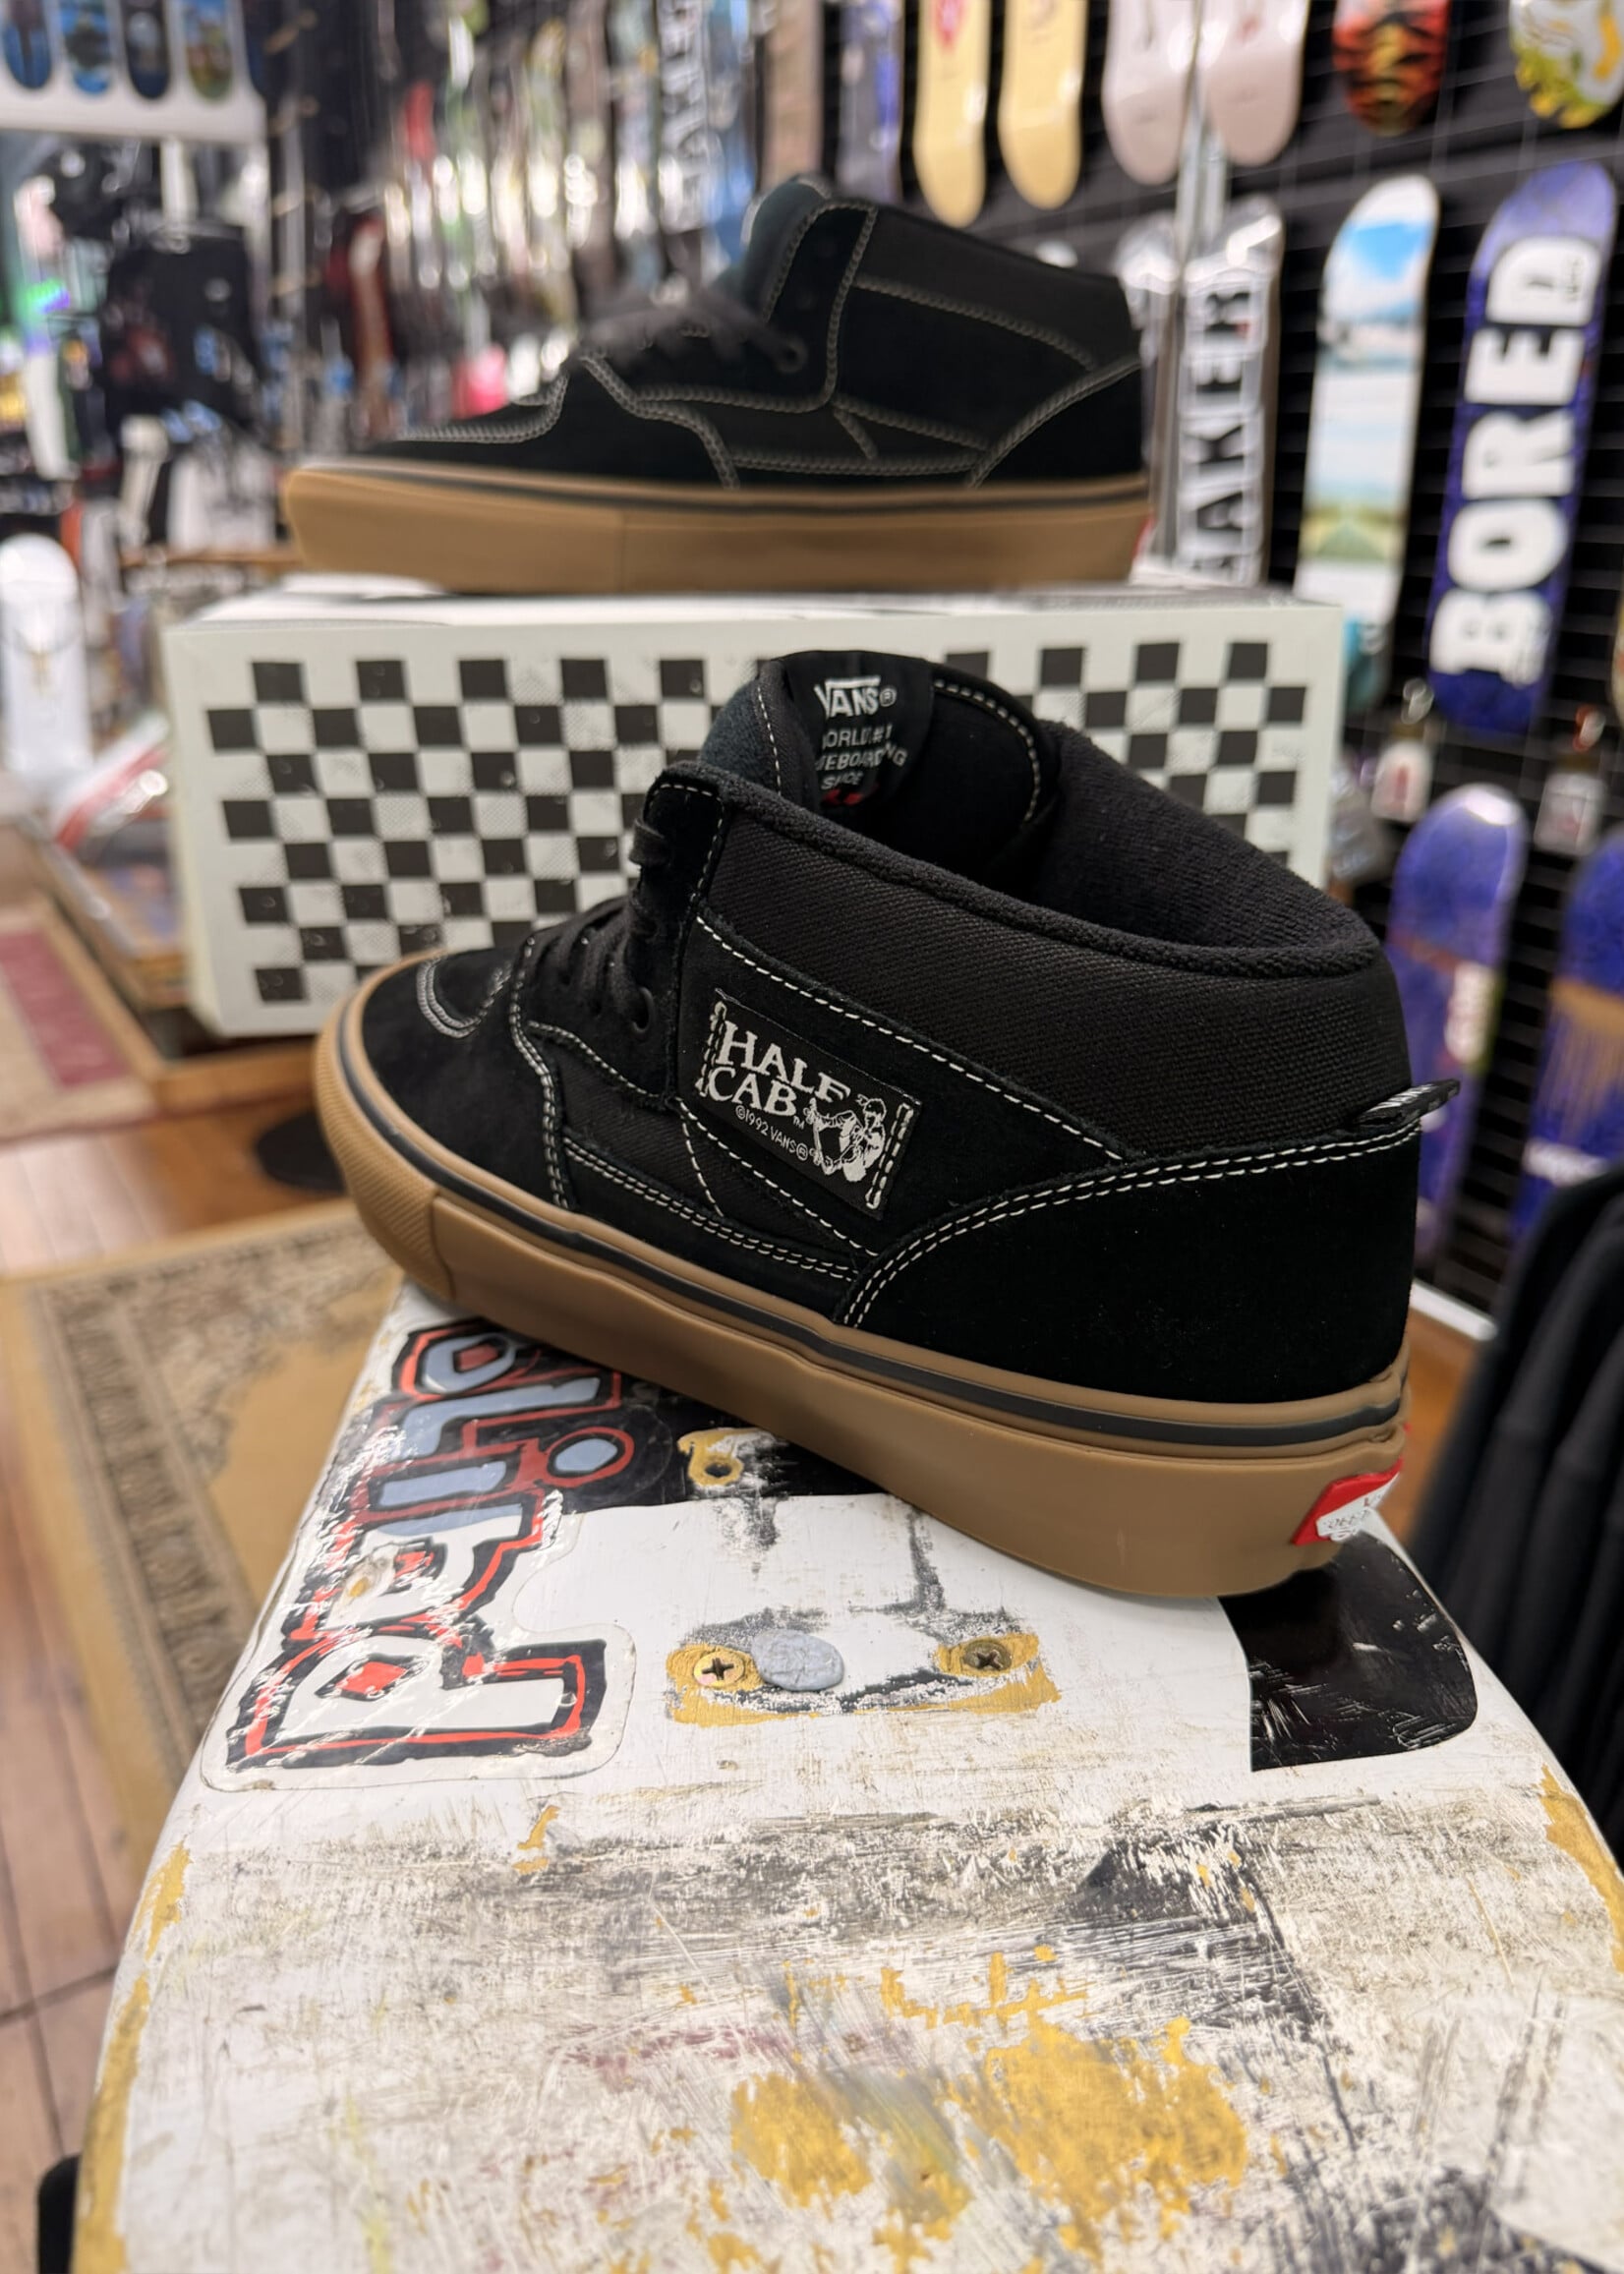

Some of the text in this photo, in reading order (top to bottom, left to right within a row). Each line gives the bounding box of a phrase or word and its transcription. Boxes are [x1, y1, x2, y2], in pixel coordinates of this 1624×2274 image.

[1429, 236, 1599, 684] BORED
[823, 729, 871, 749] ORLD
[716, 1020, 851, 1103] HALF
